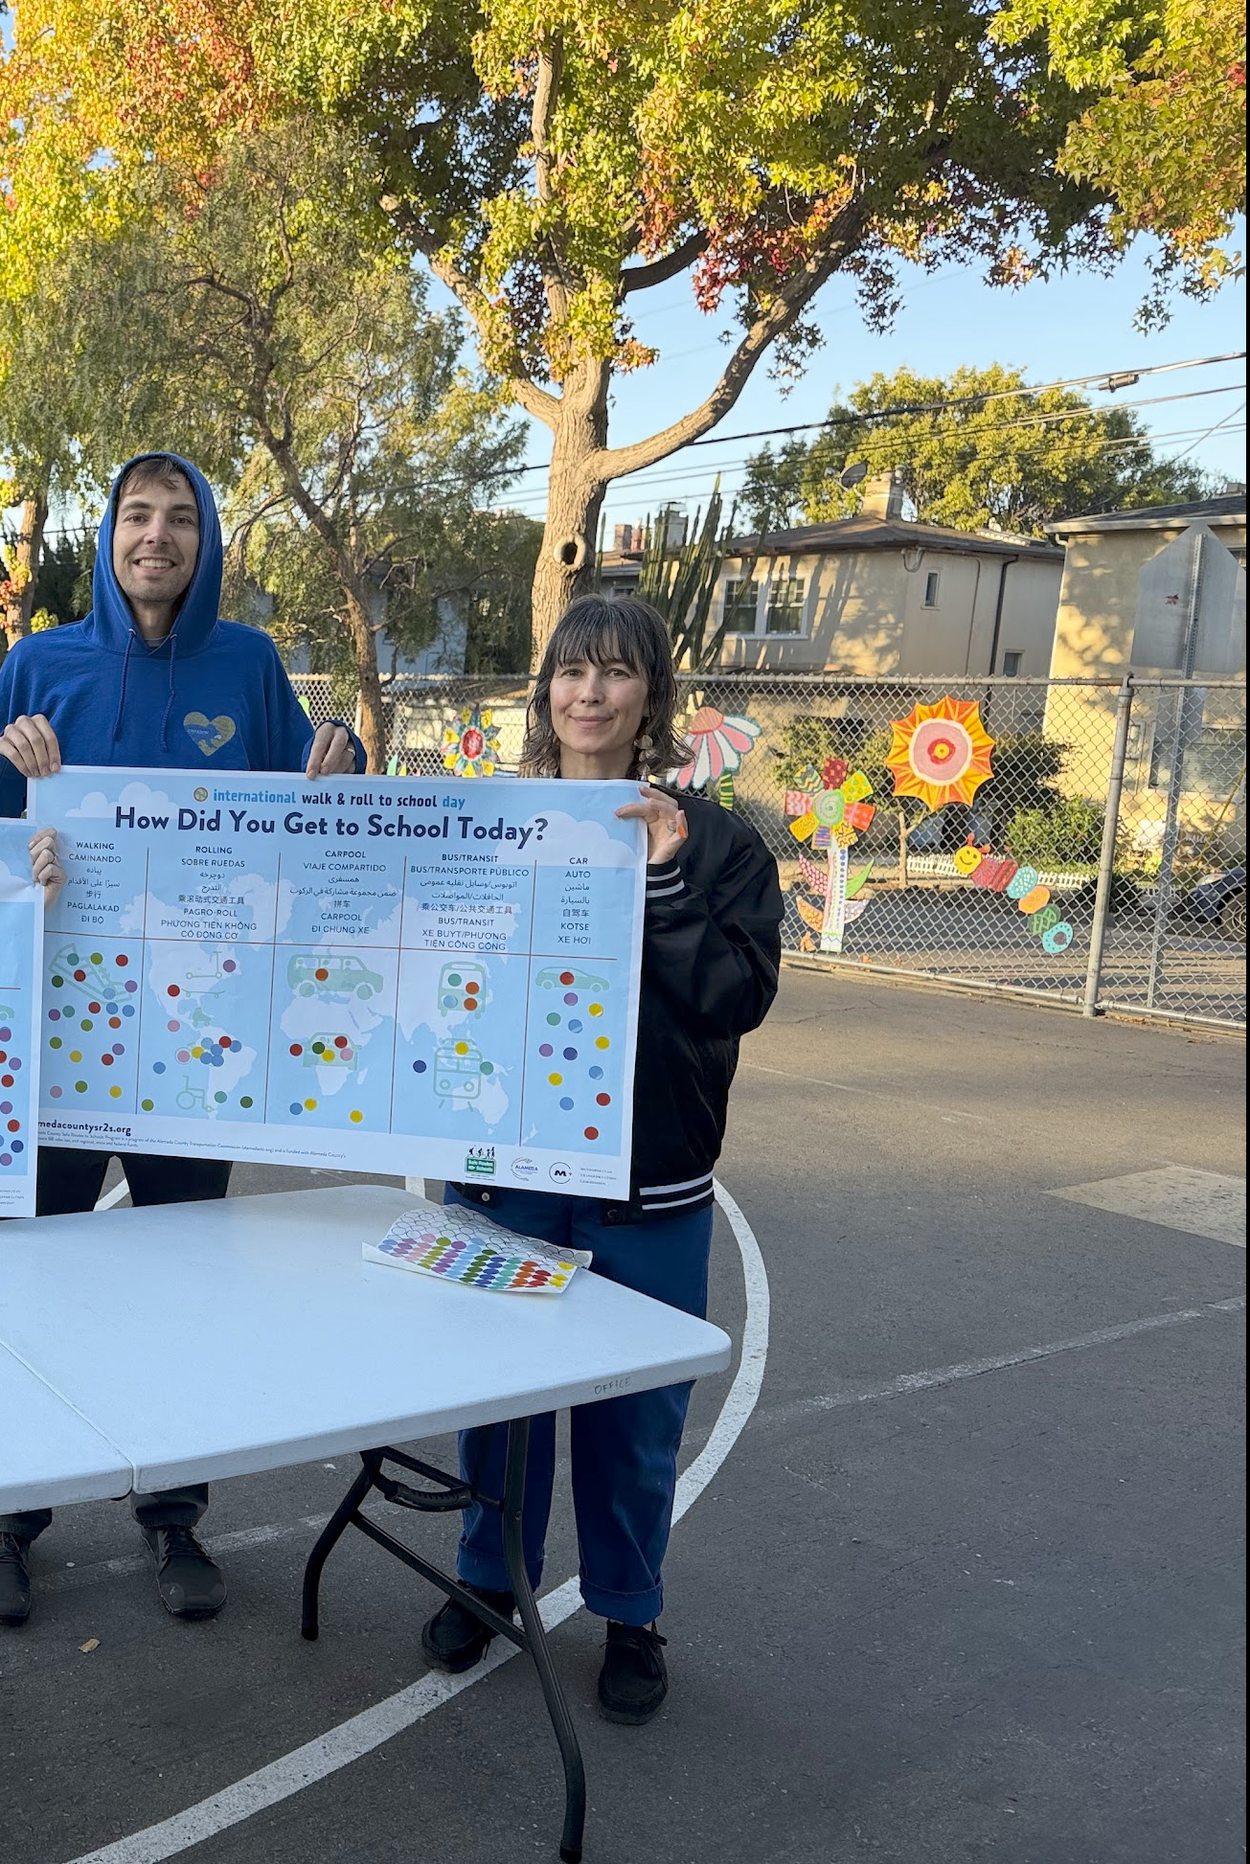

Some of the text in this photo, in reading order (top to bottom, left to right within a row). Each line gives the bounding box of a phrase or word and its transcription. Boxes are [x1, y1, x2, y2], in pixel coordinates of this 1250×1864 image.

[213, 789, 466, 810] international walk & roll to school day
[115, 806, 549, 850] How Did You Get to School Today?
[76, 841, 115, 850] WALKING
[195, 846, 233, 855] ROLLING
[325, 850, 366, 859] CARPOOL
[68, 853, 122, 863] CAMINANDO
[441, 853, 499, 863] BUS/TRANSIT
[569, 857, 589, 865] CAR
[181, 858, 246, 868] SOBRE RUEDAS
[303, 862, 386, 872] VIAJE COMPARTIDO
[410, 865, 530, 877] BUS/TRANSPORTE PÚBLICO
[565, 870, 591, 879] AUTO
[67, 901, 120, 913] PAGLALAKAD
[81, 915, 90, 923] ĐI
[321, 913, 363, 922] CARPOOL
[438, 917, 495, 927] BUS/TRANSIT
[311, 925, 370, 934] ĐI CHUNG XE
[560, 922, 590, 931] KOTSE
[422, 929, 434, 937] XE
[557, 935, 571, 944] XE
[594, 1376, 631, 1395] OFFICE
